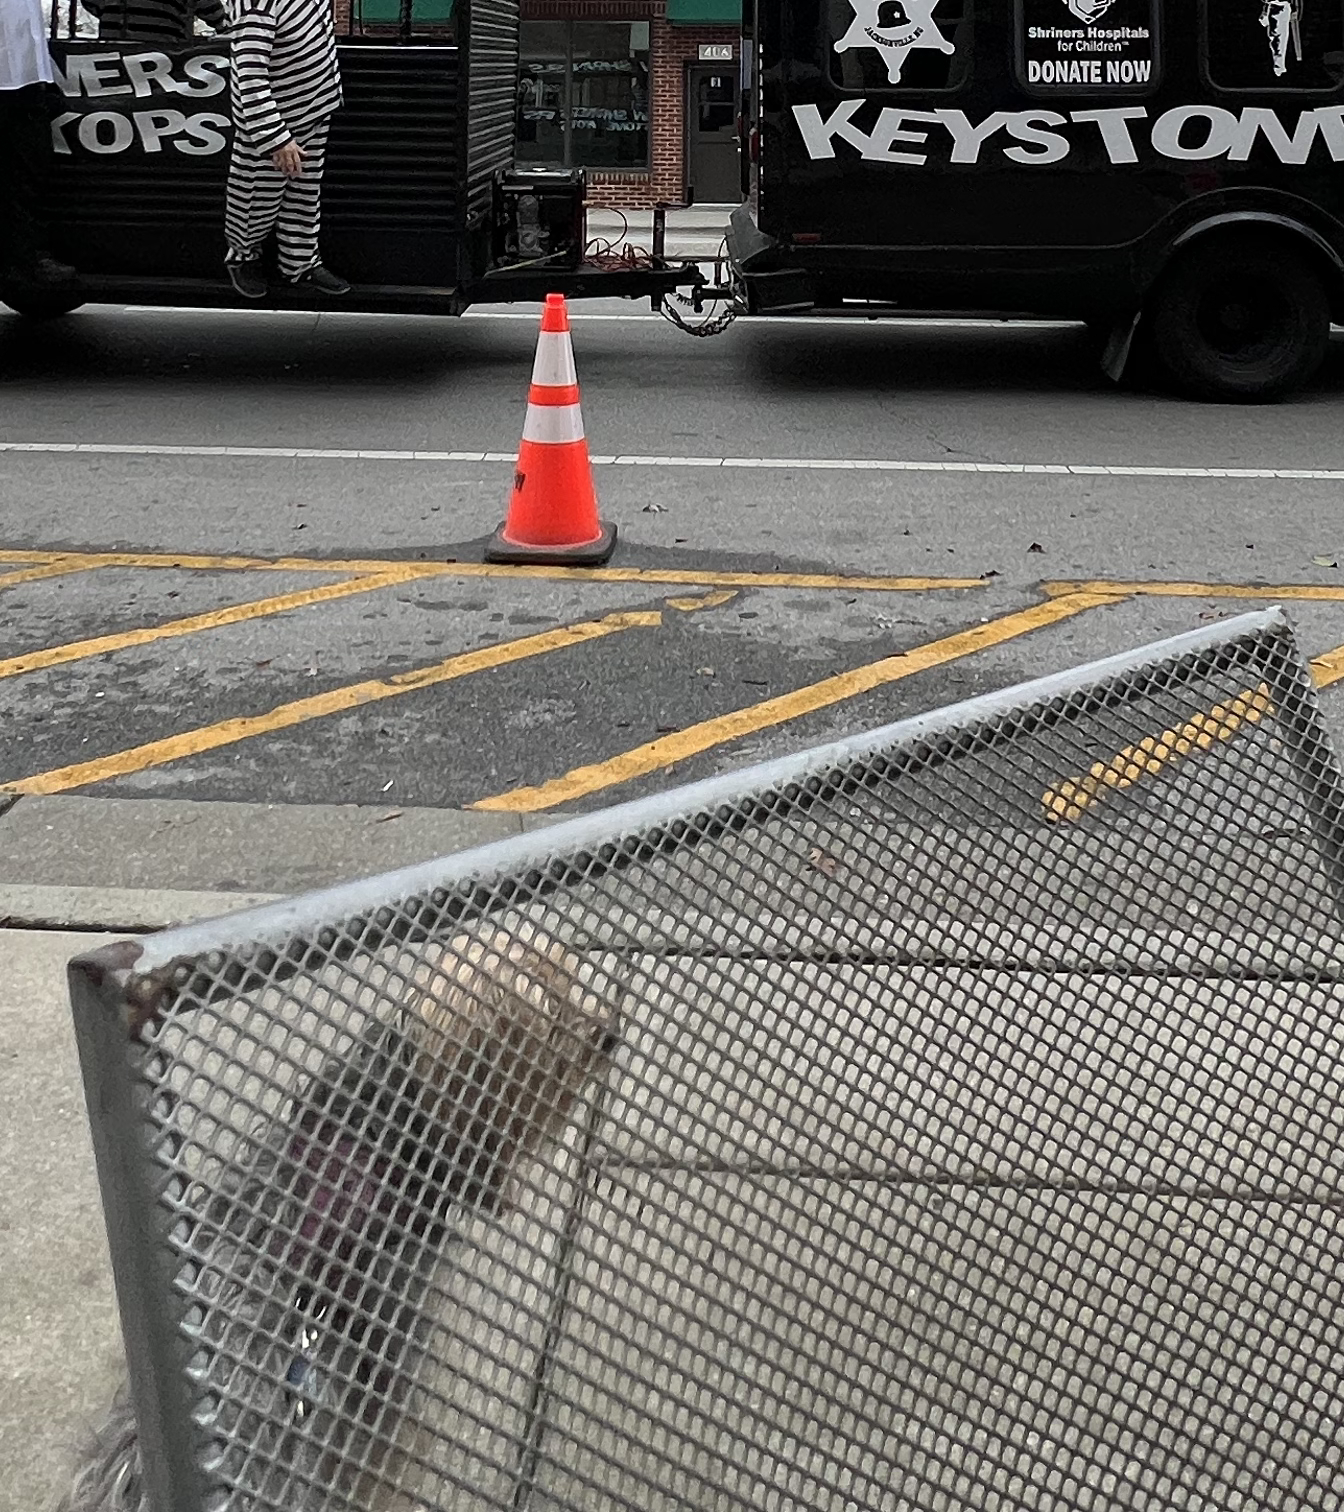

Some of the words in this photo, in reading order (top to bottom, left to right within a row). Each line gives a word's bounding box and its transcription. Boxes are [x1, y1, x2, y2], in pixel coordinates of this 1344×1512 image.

[1028, 26, 1085, 39] Shriners
[1087, 26, 1150, 40] Hospitals
[1057, 40, 1073, 51] for
[1028, 60, 1102, 83] DONATE
[1106, 60, 1151, 83] NOW
